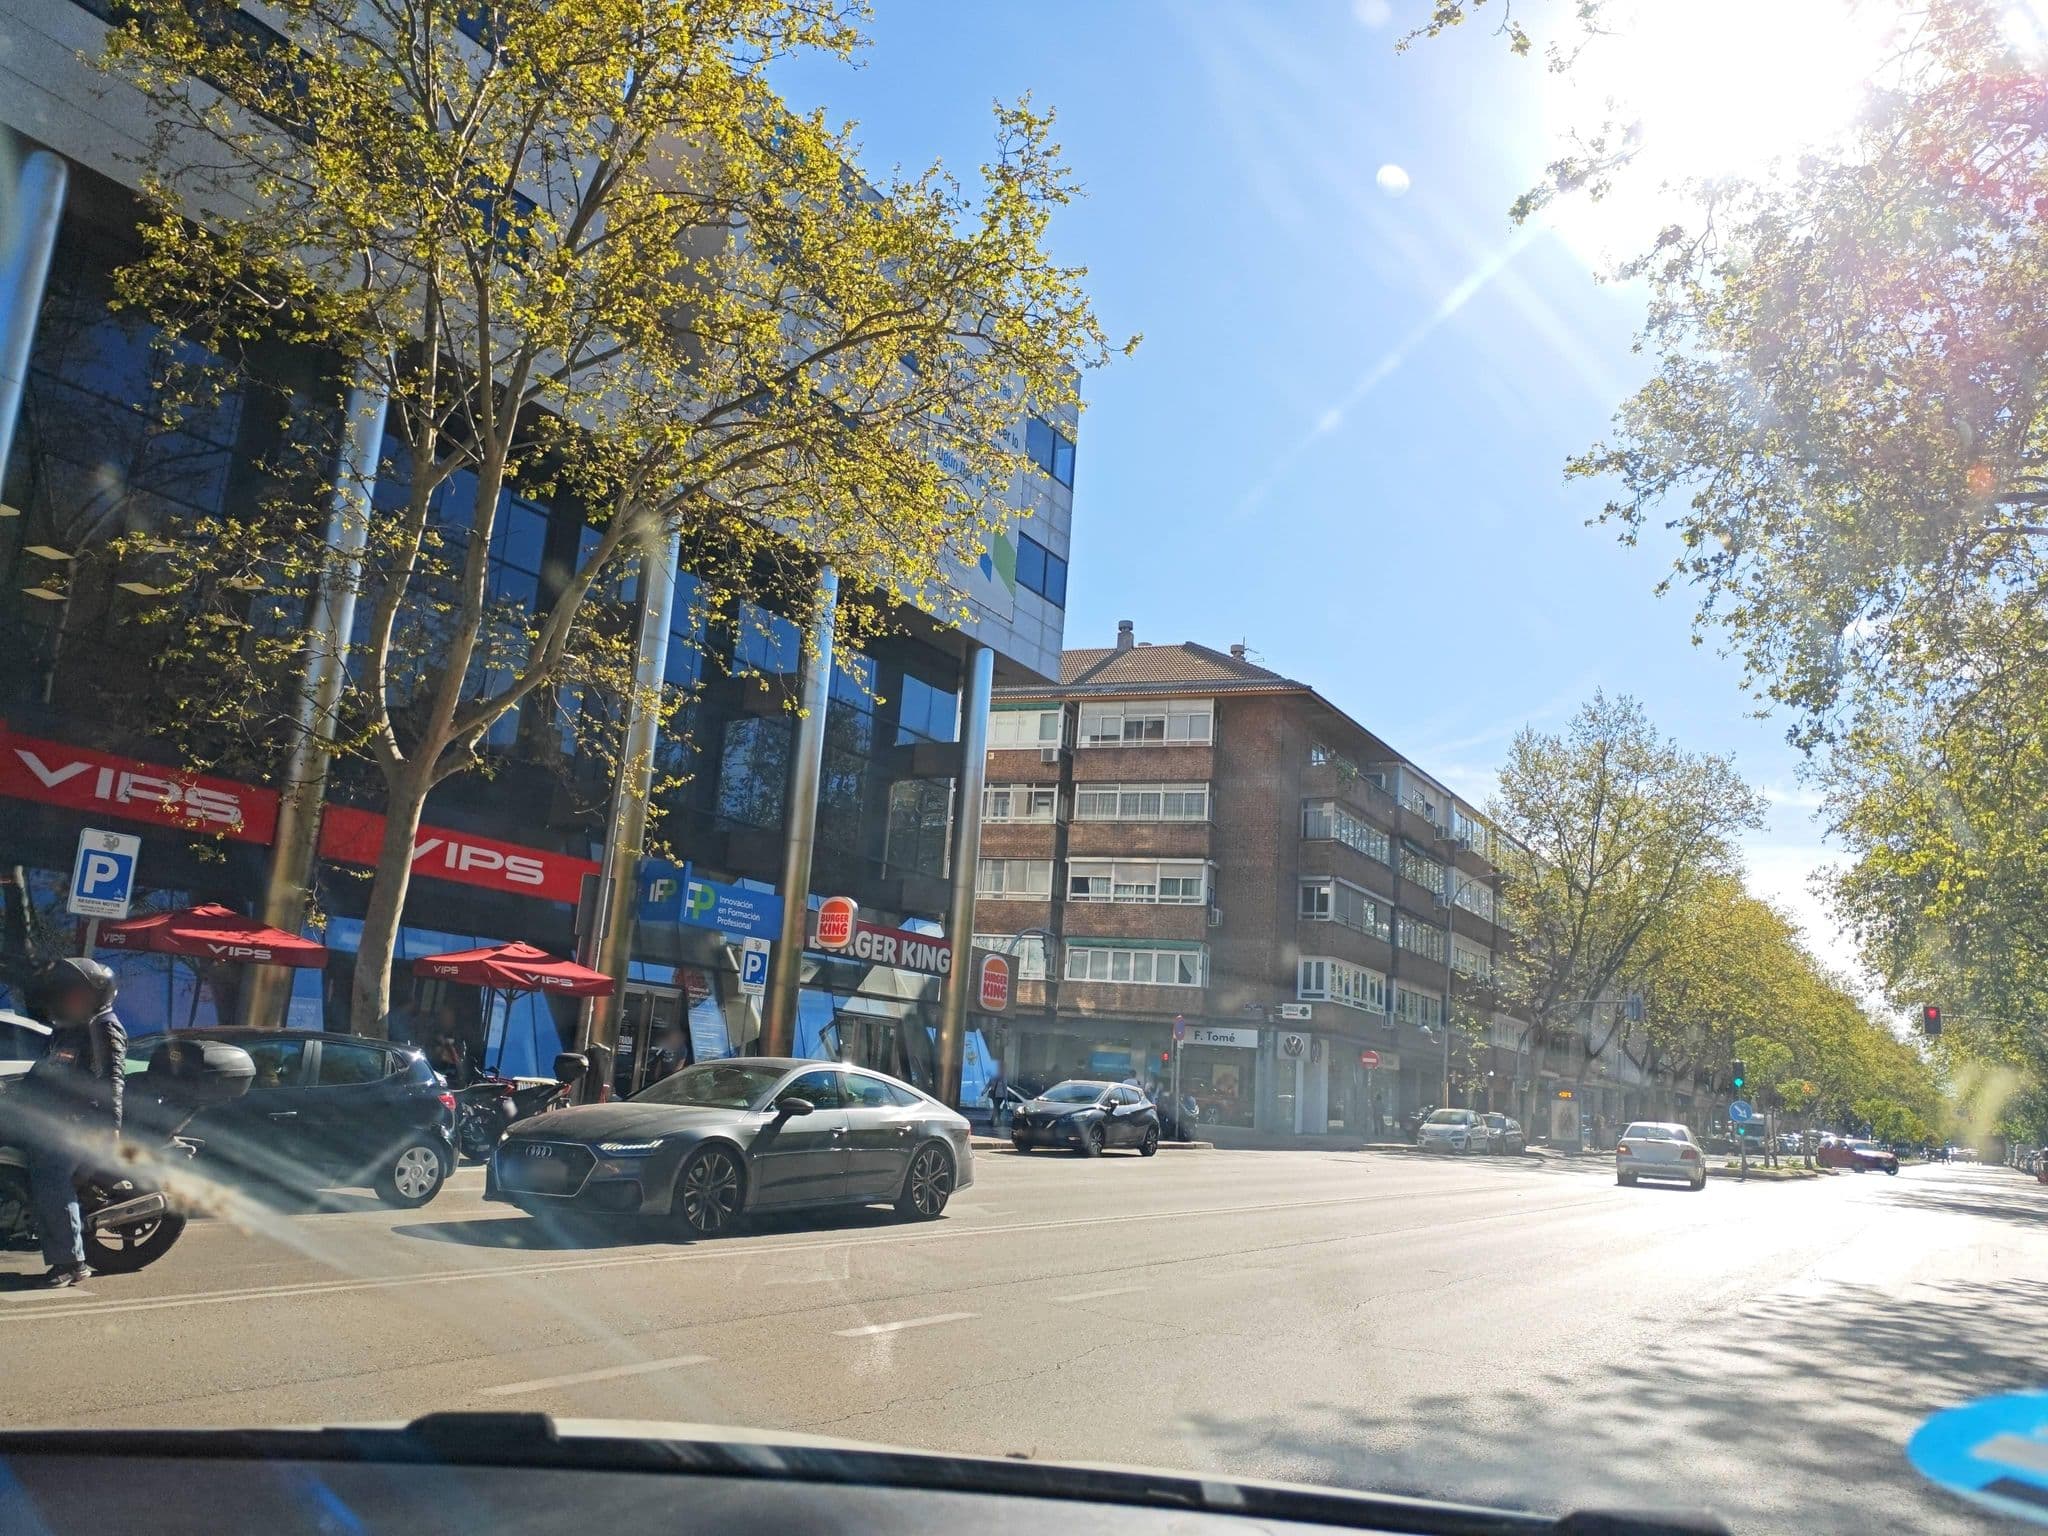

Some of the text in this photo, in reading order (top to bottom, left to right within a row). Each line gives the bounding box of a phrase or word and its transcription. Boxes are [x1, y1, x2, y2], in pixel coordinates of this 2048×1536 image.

[14, 749, 243, 824] VIPS
[83, 854, 119, 893] P
[719, 896, 754, 910] Innovación
[718, 907, 761, 921] en Formación
[820, 912, 849, 923] BURGER
[717, 916, 752, 930] Profesional
[819, 922, 848, 936] KING
[103, 932, 126, 944] VIPS
[208, 944, 271, 960] VIPS
[901, 940, 951, 974] KING
[433, 965, 459, 975] VIPS
[745, 953, 761, 980] P
[526, 973, 574, 987] VIPS
[983, 971, 1007, 984] BURGER
[983, 982, 1007, 1000] KING
[1194, 1030, 1236, 1043] F. Tomé
